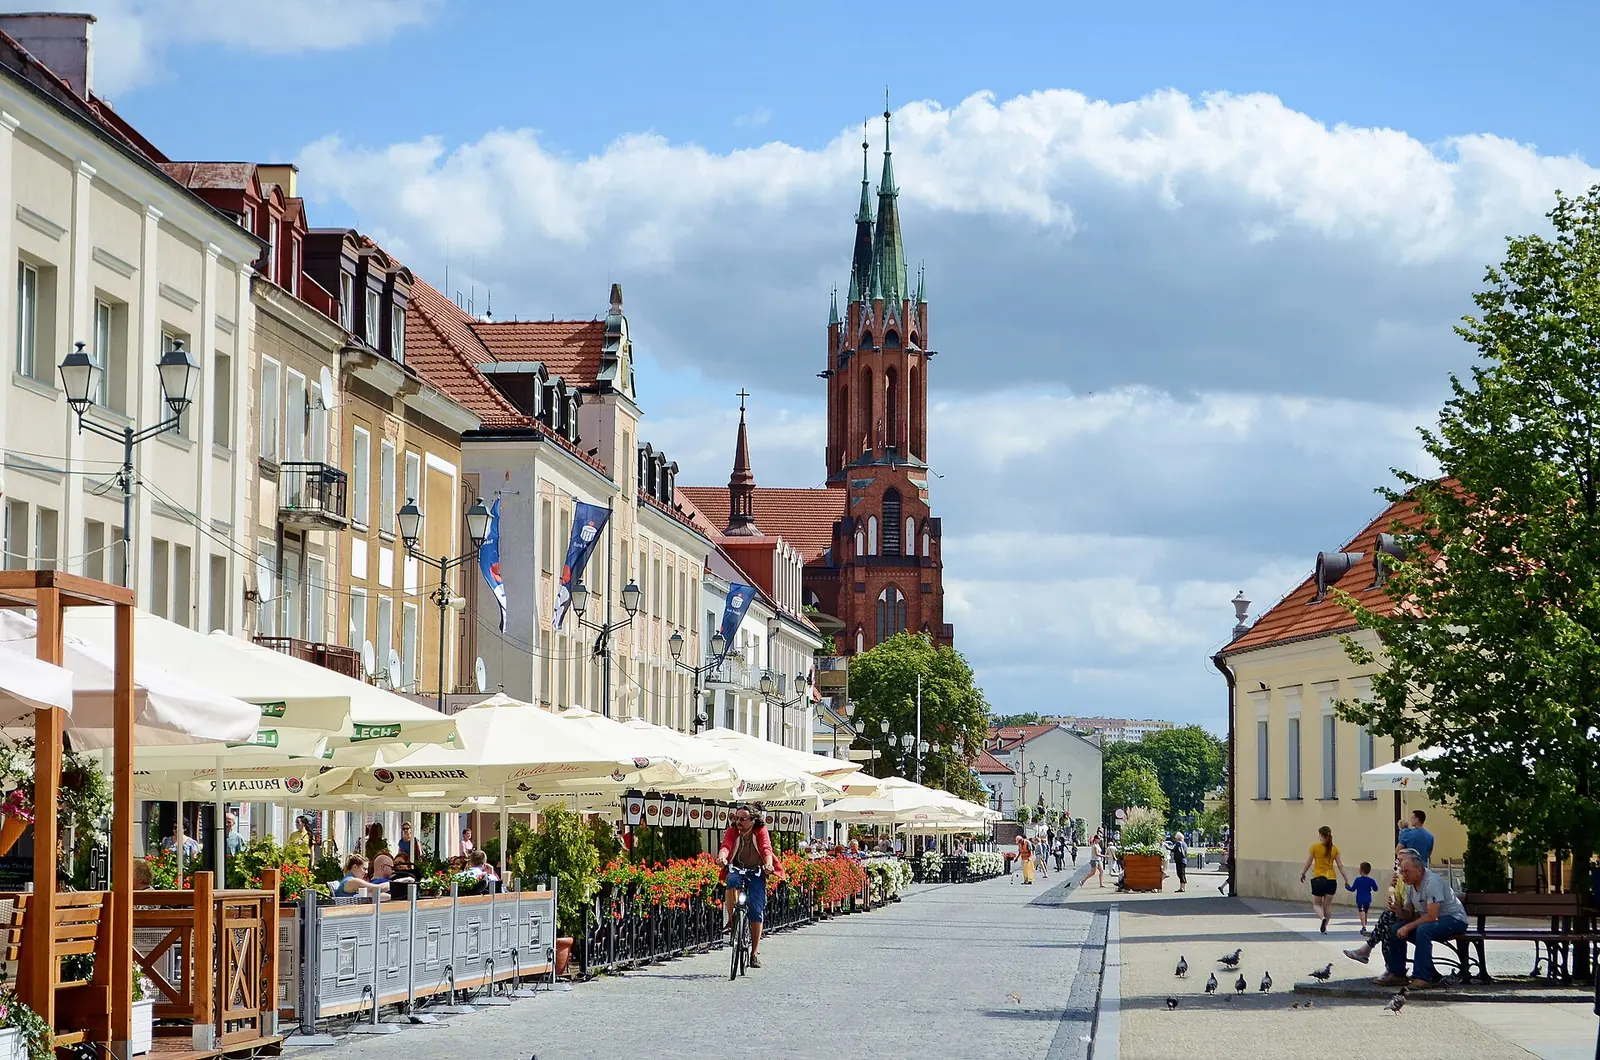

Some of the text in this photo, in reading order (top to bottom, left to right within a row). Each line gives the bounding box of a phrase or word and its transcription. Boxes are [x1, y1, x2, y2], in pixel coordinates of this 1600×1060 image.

[352, 727, 391, 739] LECH
[396, 769, 469, 780] PAULANER
[745, 782, 778, 793] PAULANER
[764, 798, 807, 808] PAULANER
